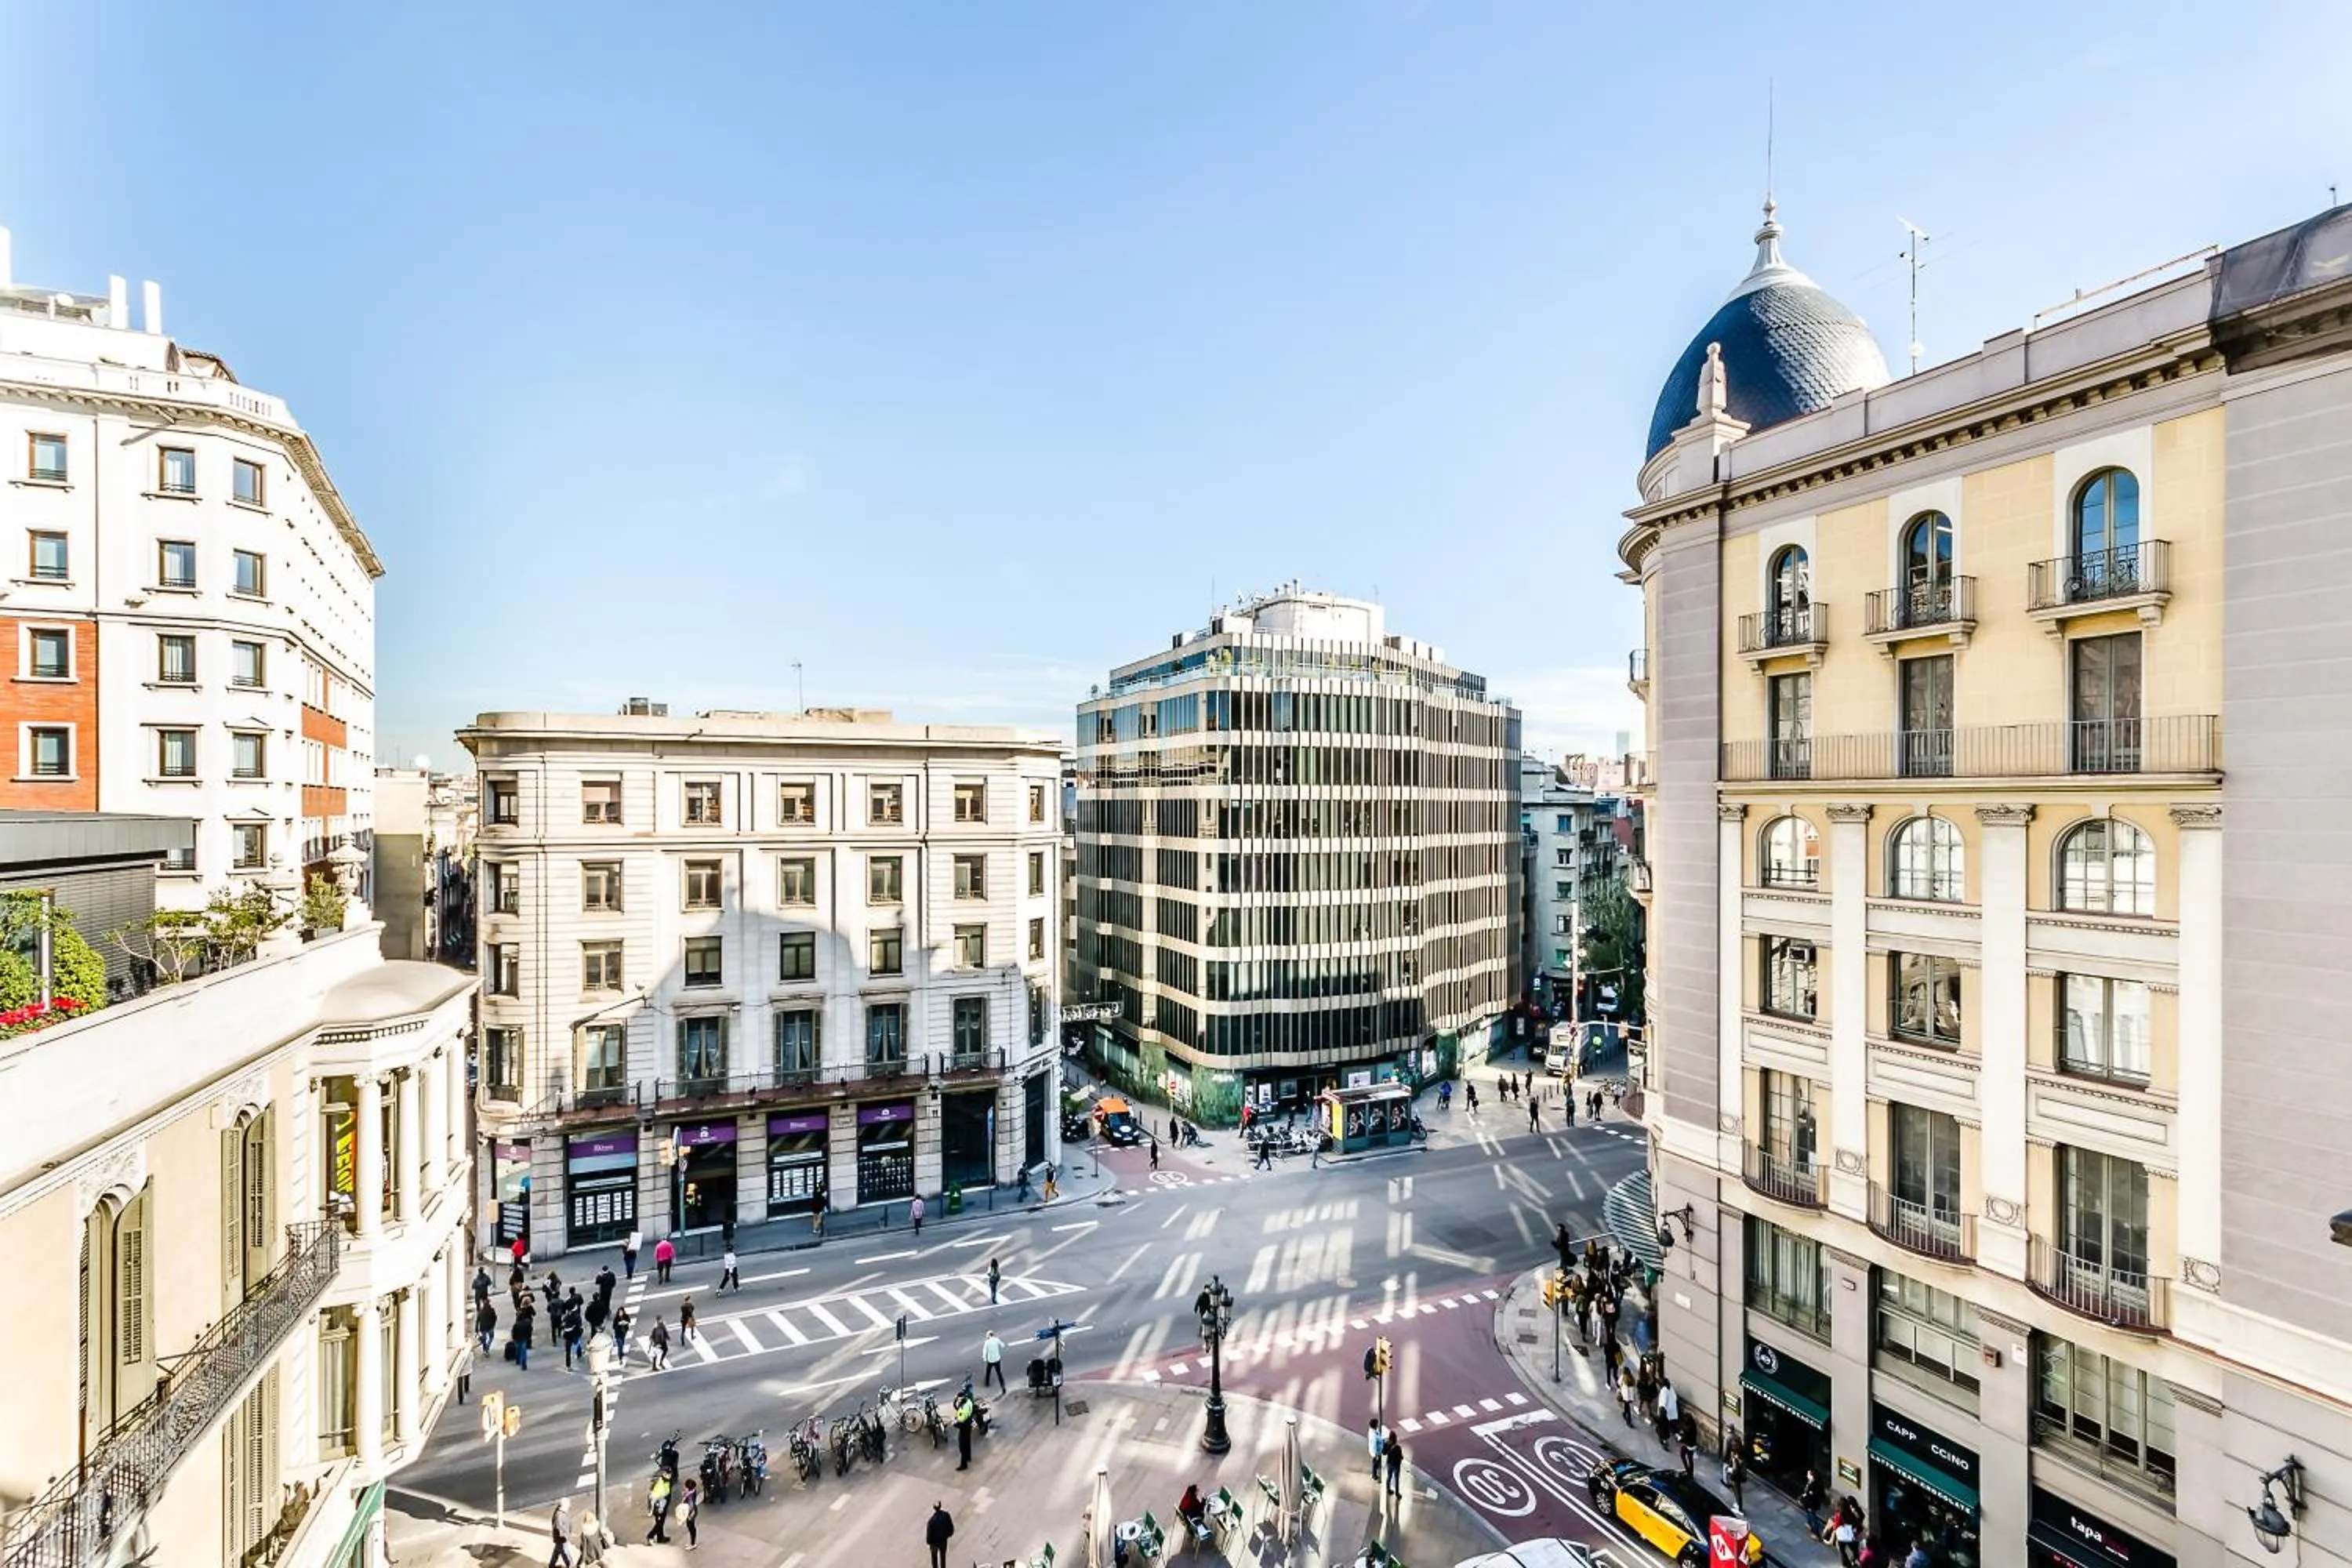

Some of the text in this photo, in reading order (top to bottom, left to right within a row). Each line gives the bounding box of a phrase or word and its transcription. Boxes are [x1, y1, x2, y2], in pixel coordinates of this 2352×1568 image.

[1886, 1420, 1969, 1470] CAPP CCINO
[2071, 1515, 2103, 1543] tapa
